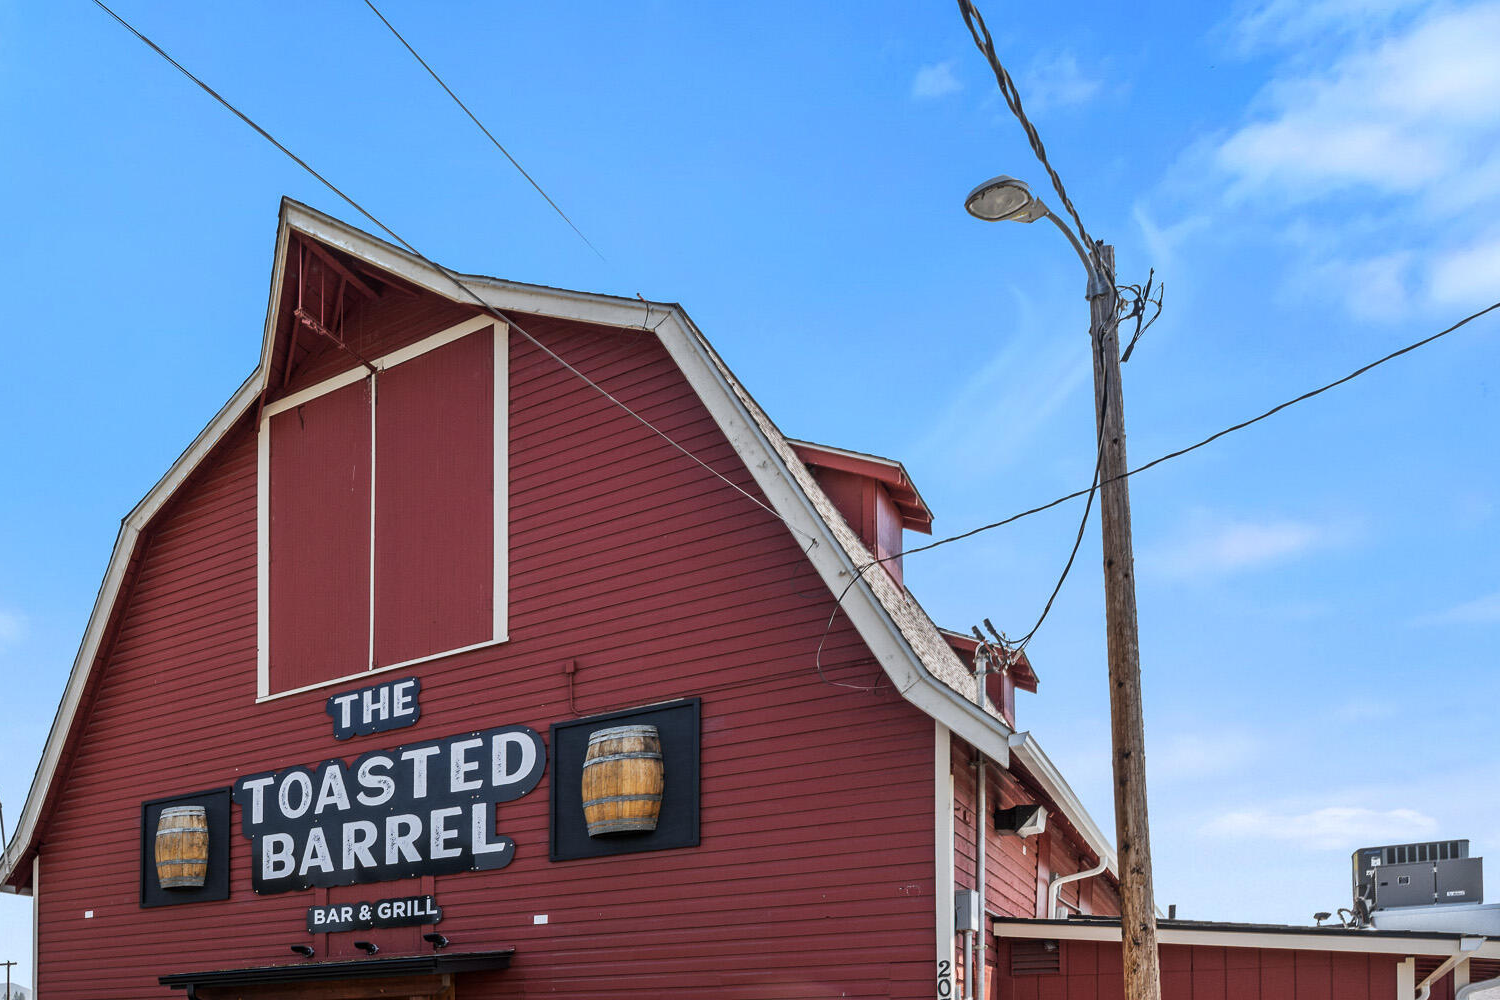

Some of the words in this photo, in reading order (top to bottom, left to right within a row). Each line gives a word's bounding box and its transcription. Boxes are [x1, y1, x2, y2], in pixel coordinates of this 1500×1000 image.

[334, 680, 415, 729] THE
[242, 732, 537, 824] TOASTED
[261, 803, 506, 880] BARREL
[314, 906, 353, 925] BAR
[358, 904, 372, 921] &
[377, 898, 438, 919] GRILL
